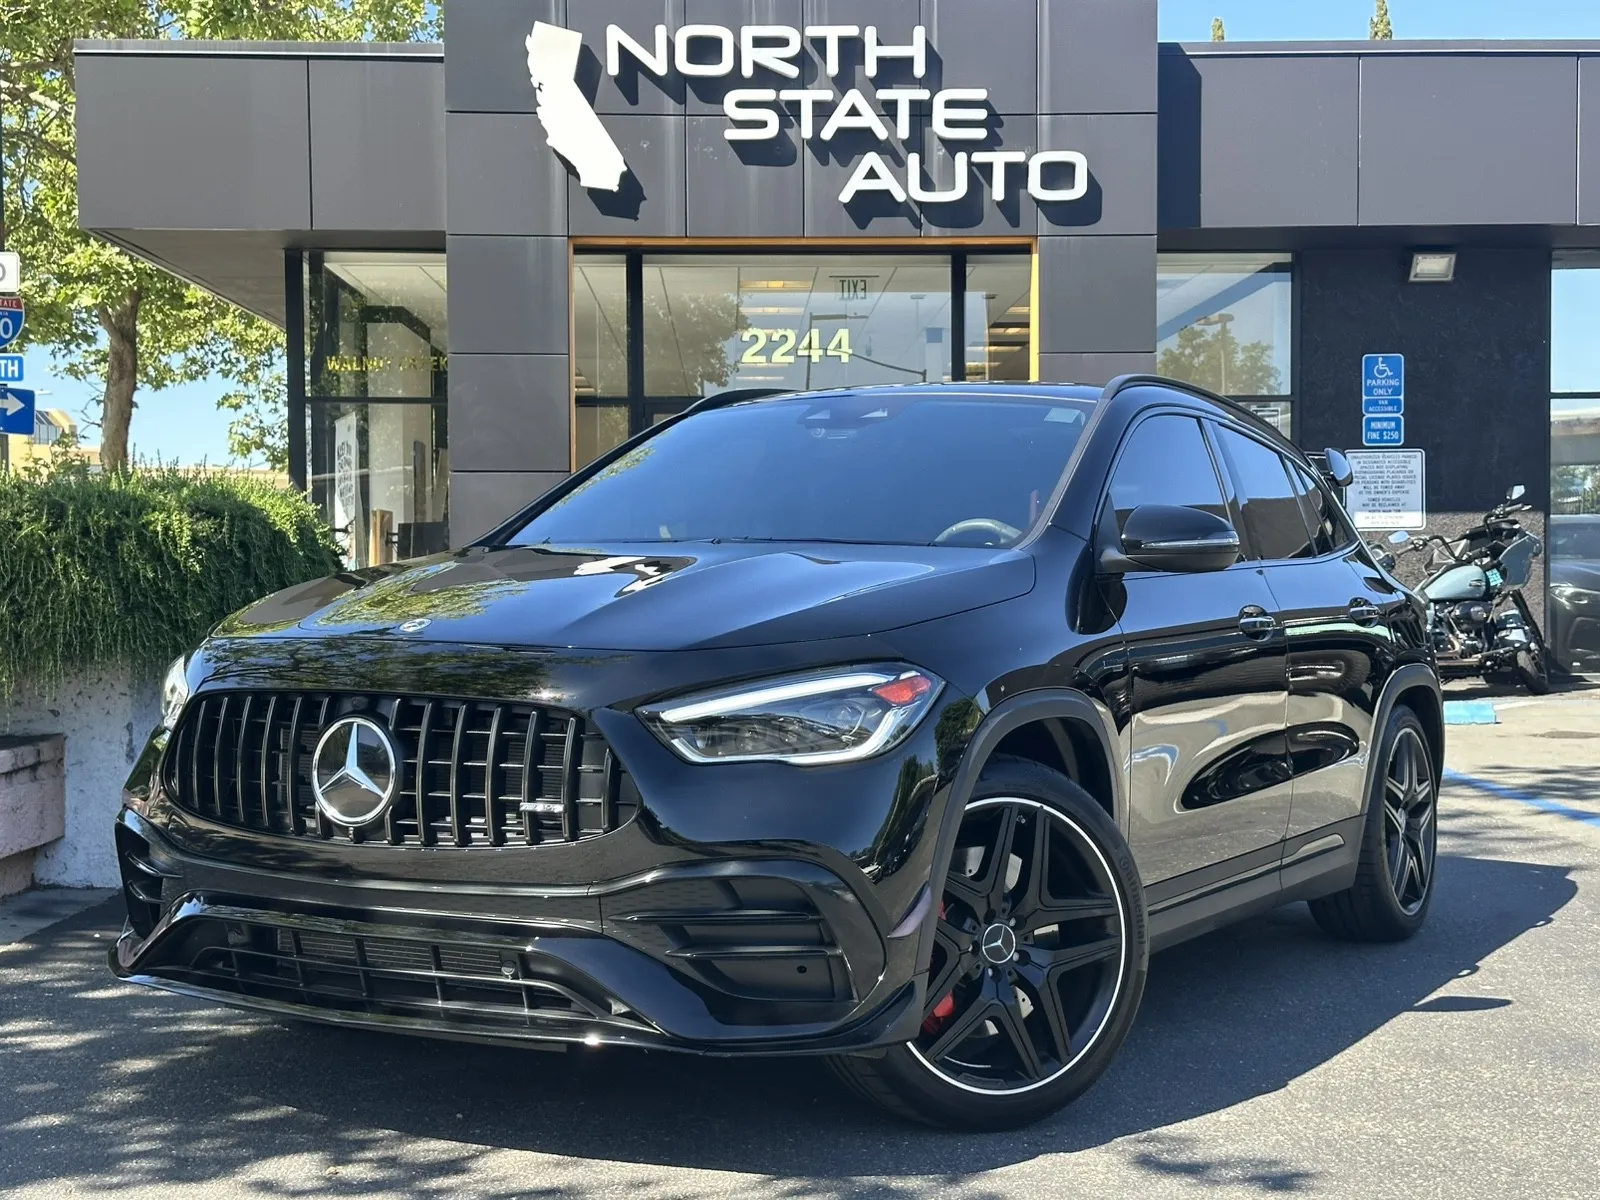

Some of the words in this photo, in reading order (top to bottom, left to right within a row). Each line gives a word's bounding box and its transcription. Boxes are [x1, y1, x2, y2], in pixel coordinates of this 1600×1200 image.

[606, 24, 926, 79] NORTH
[723, 88, 988, 141] STATE
[837, 150, 1088, 203] AUTO
[741, 327, 853, 363] 2244
[1366, 378, 1400, 387] PARKING
[1373, 388, 1393, 396] ONLY
[1367, 431, 1380, 440] FINE
[1383, 431, 1399, 440] $250
[1370, 421, 1396, 430] MINIMUM
